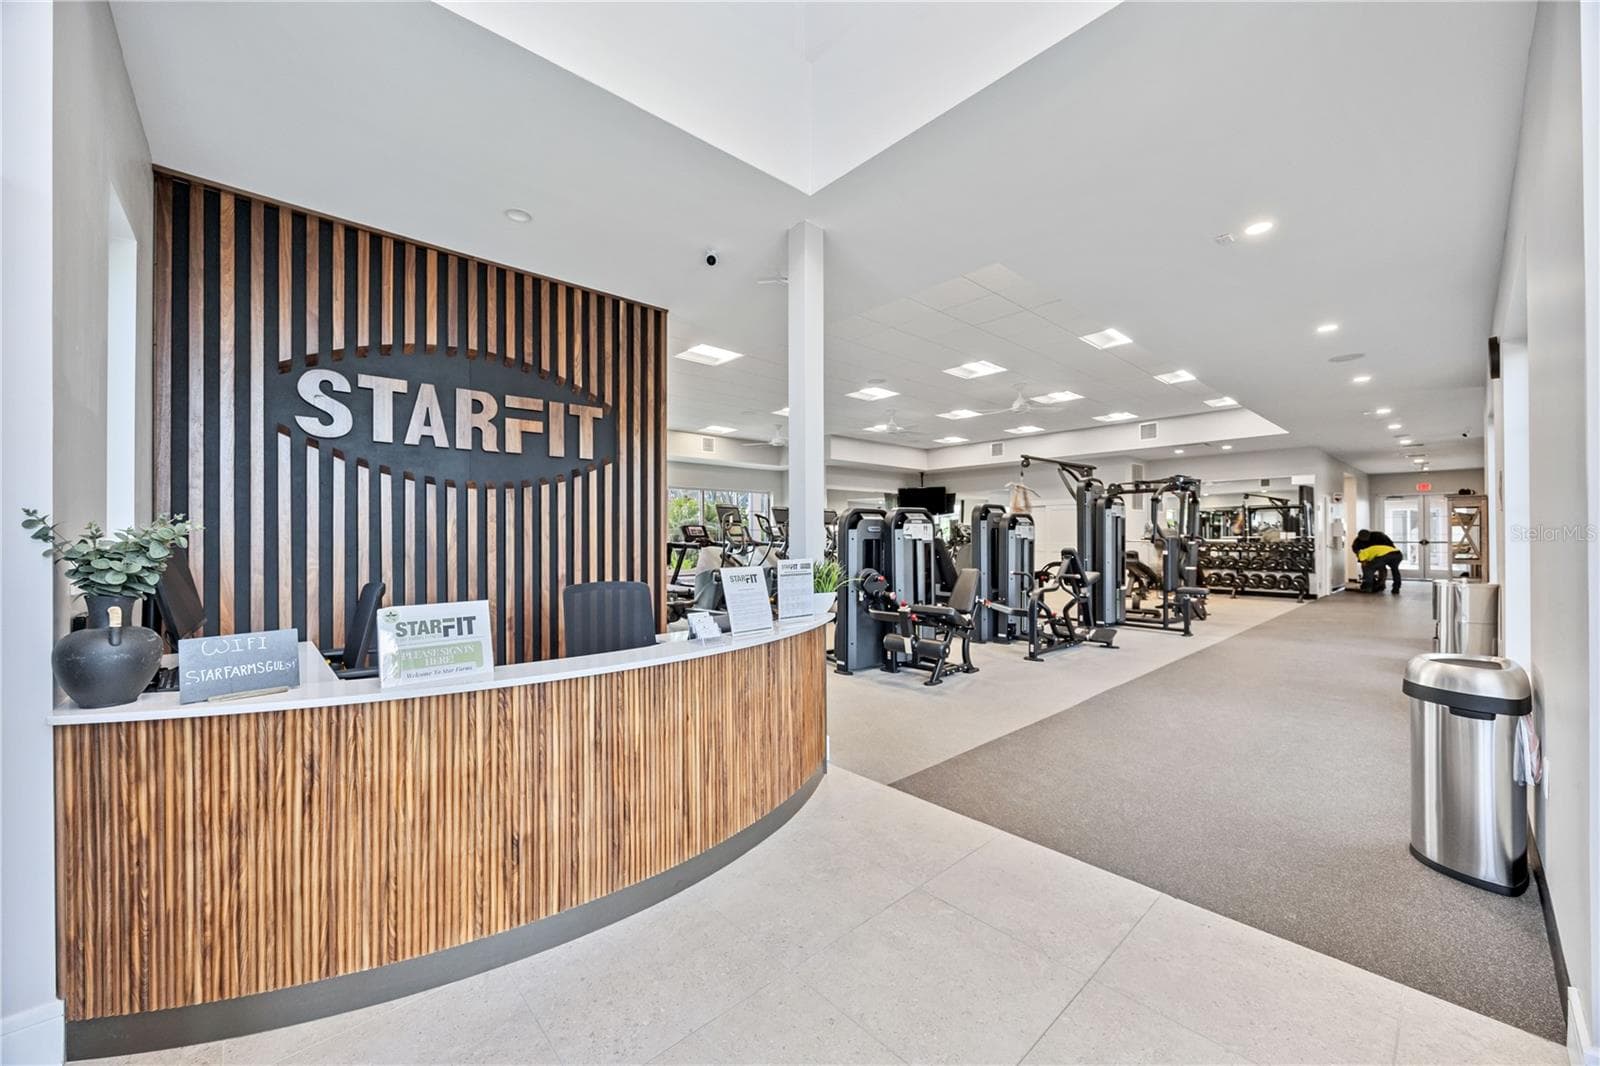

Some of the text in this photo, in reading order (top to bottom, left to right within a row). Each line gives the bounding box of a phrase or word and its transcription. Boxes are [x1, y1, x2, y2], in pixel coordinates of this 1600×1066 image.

[294, 368, 604, 460] STARFIT
[729, 573, 758, 584] STARFIT
[395, 616, 476, 637] STARFIT
[201, 636, 267, 656] WIFI
[401, 647, 438, 660] PLEASE
[406, 671, 432, 679] Welcome
